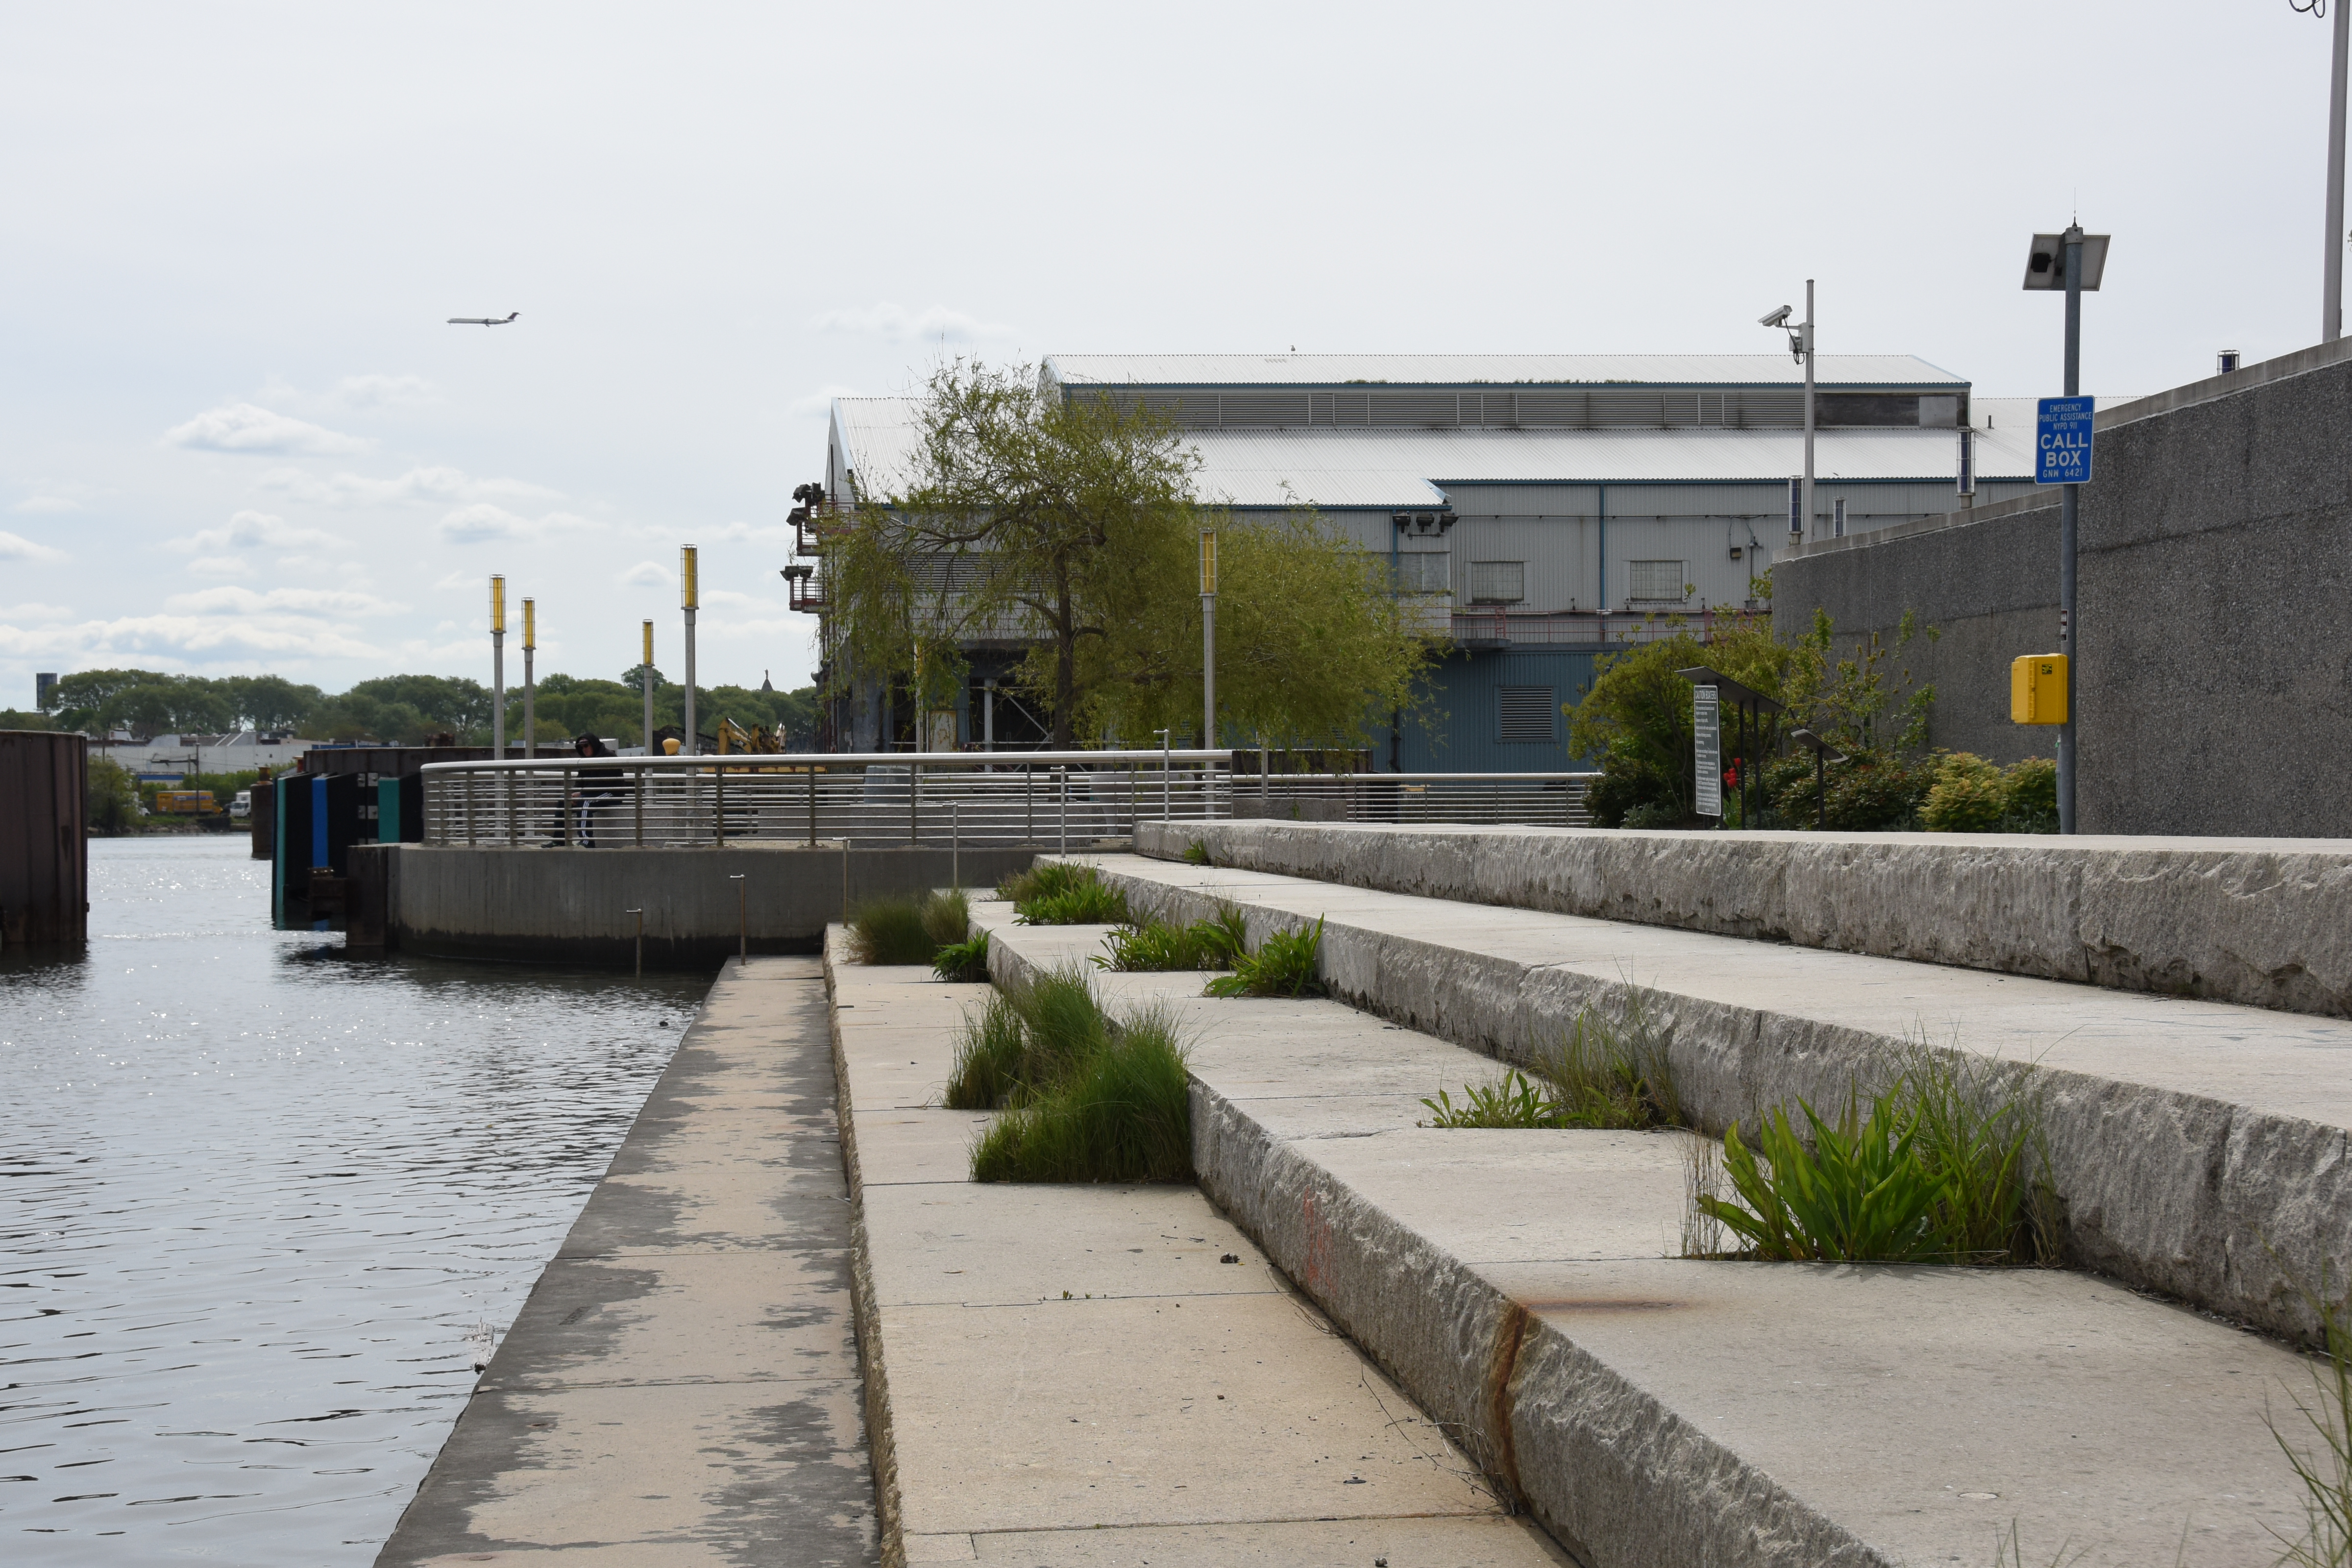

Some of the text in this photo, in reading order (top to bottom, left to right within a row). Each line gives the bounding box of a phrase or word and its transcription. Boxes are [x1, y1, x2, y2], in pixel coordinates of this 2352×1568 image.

[2050, 404, 2082, 413] EMERGENCY
[2039, 412, 2092, 422] PUBLIC ASSISTANCE
[2040, 432, 2088, 449] CALL
[2046, 450, 2081, 467] BOX
[2043, 467, 2082, 478] GNW 6421
